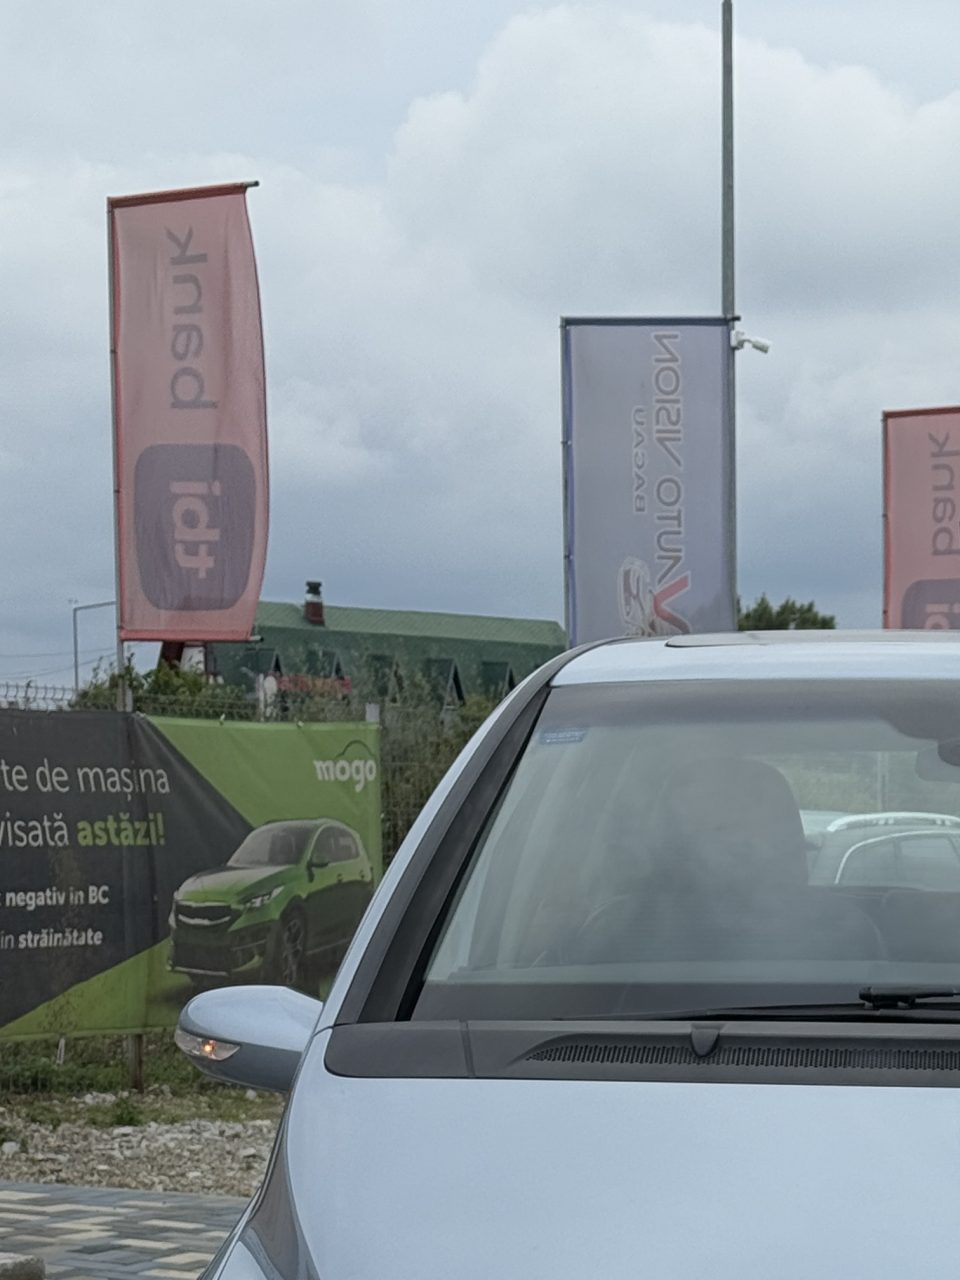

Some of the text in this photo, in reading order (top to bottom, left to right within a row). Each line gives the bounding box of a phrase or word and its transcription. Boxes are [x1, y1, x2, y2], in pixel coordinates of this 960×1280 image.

[36, 758, 70, 793] de
[313, 759, 377, 793] mogo
[77, 812, 166, 847] astăzi!
[5, 886, 66, 911] negativ
[69, 886, 85, 905] in
[88, 885, 110, 905] BC
[18, 927, 104, 949] străinătate
